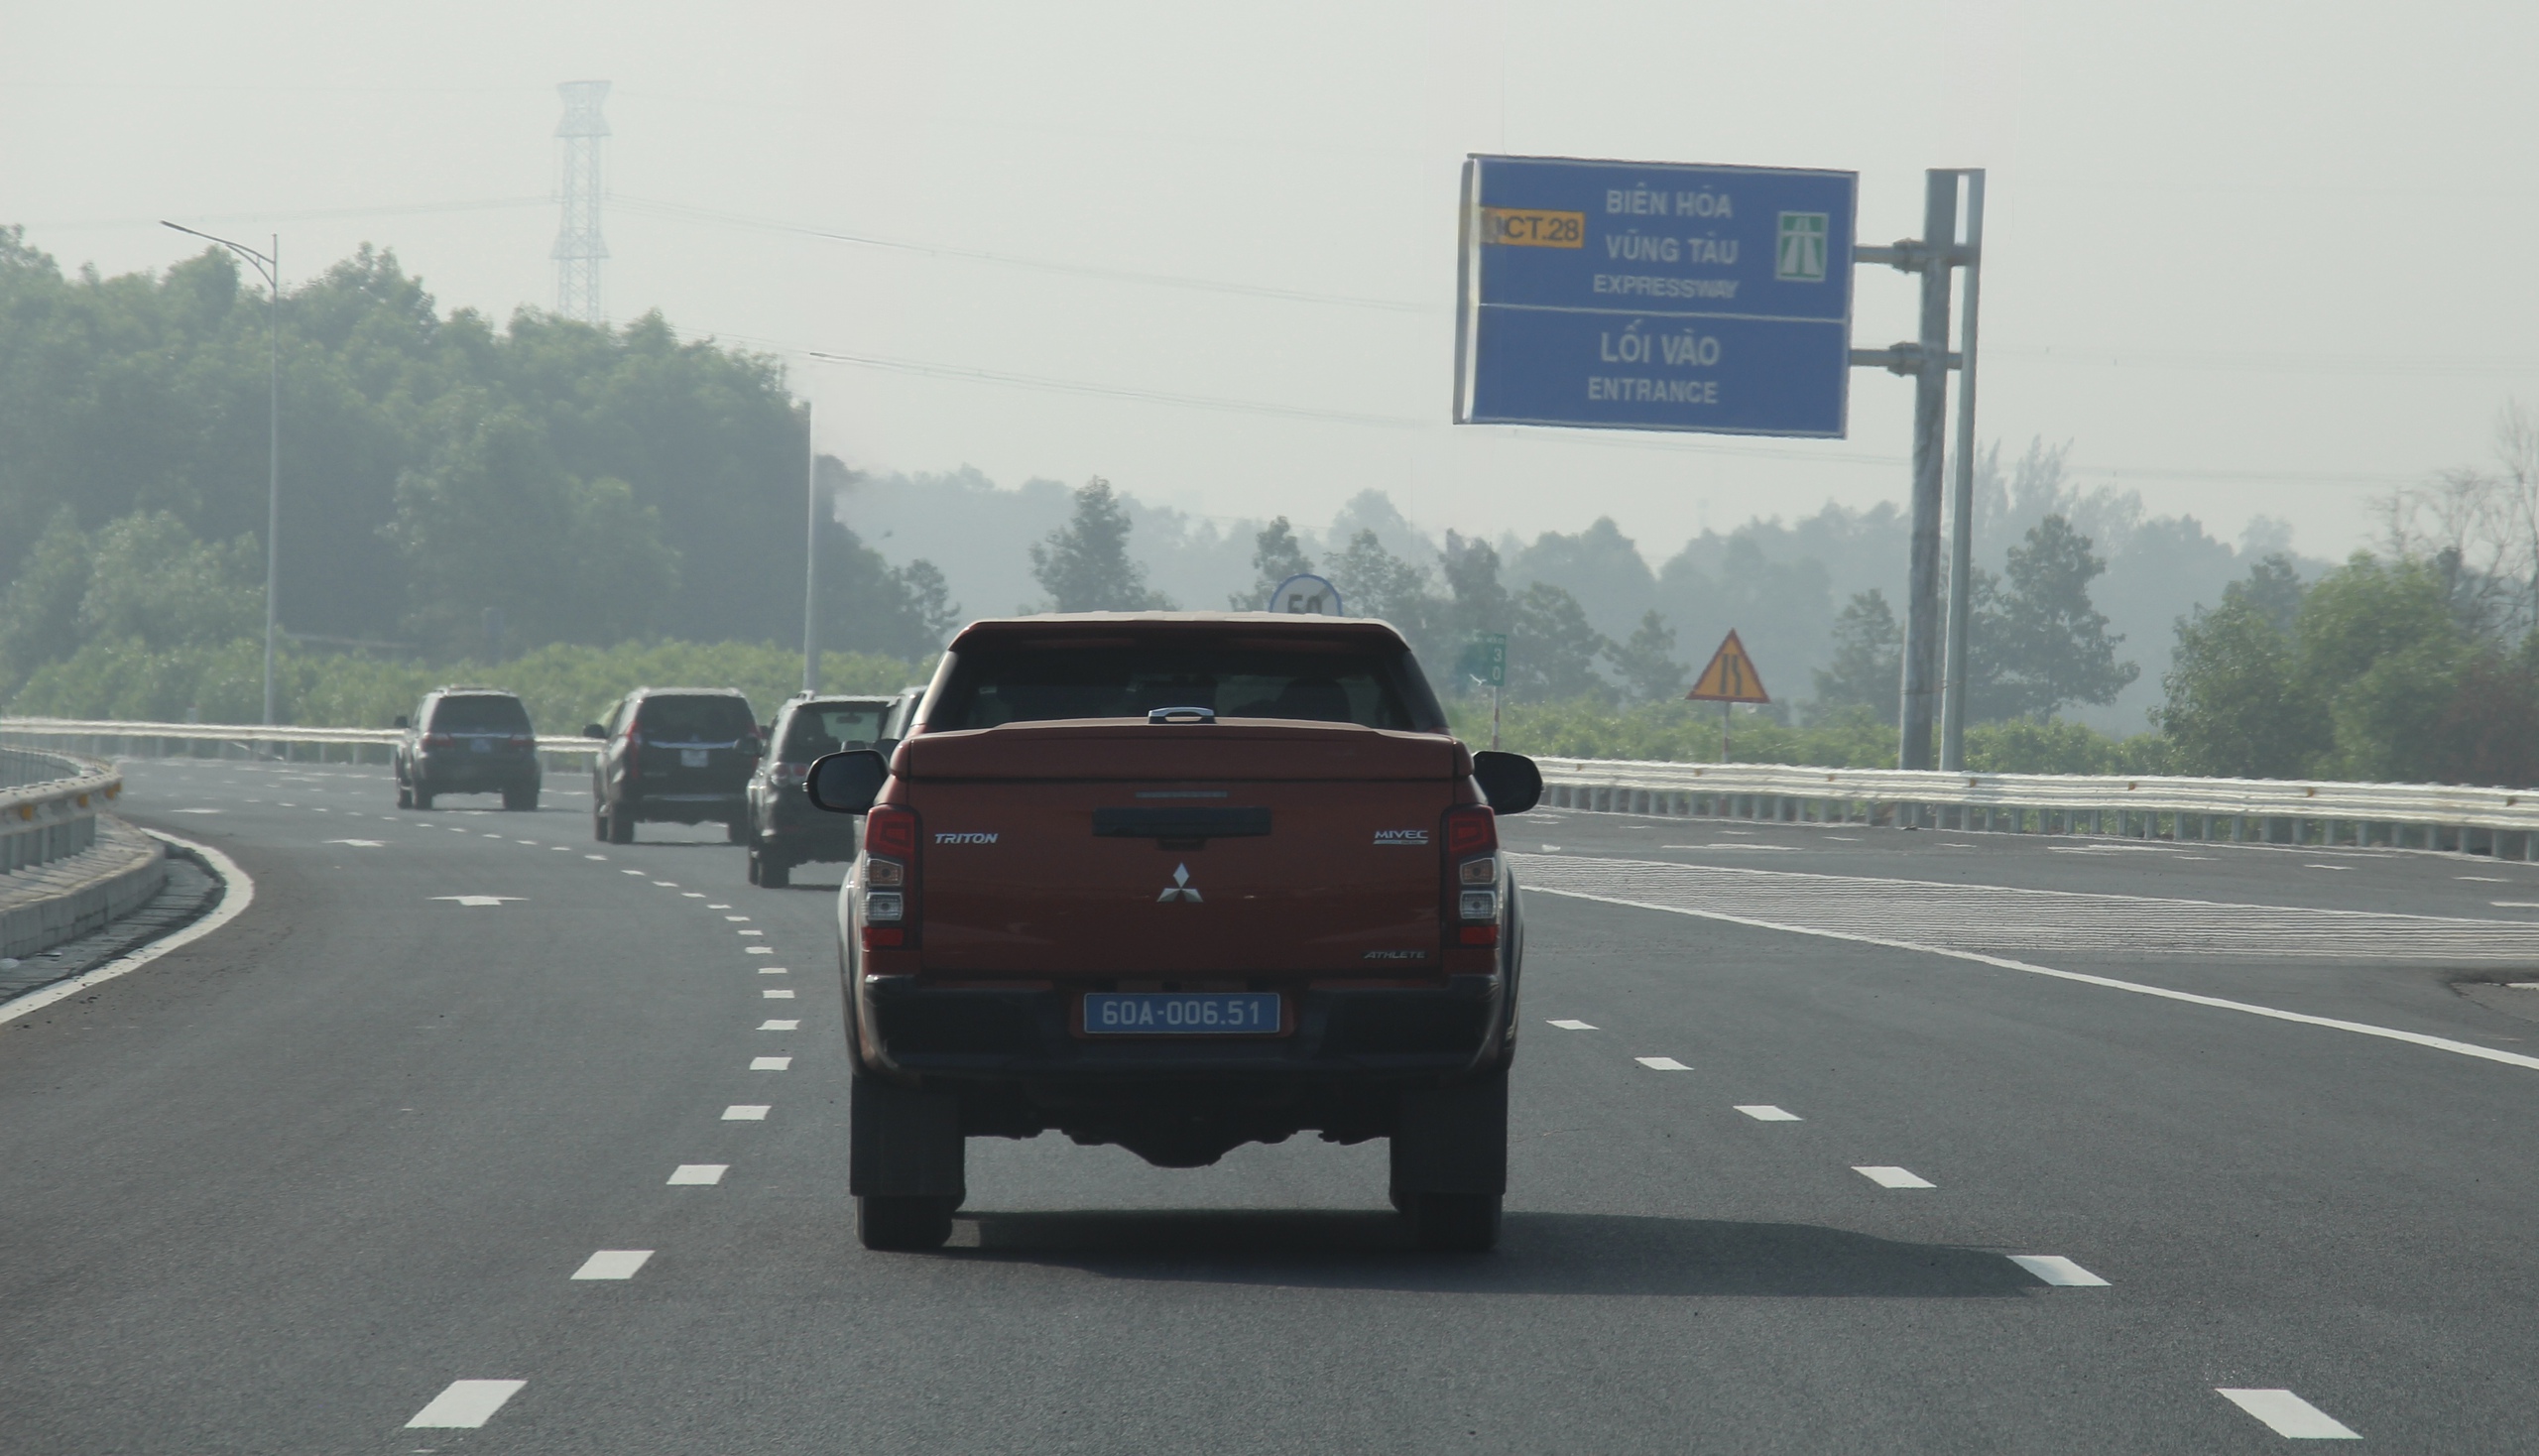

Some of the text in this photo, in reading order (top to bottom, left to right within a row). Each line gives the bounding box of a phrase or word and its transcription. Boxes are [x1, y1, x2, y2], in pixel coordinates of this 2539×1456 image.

[1606, 182, 1668, 215] BIÊN
[1606, 229, 1681, 263] VŨNG
[1593, 274, 1739, 299] EXPRESSWAY
[1601, 318, 1721, 366] LỐI VÀO
[1588, 376, 1719, 404] ENTRANCE
[935, 833, 999, 844] TRITON
[1374, 830, 1429, 839] MIVEC
[1102, 1001, 1260, 1026] 60A-006.51
